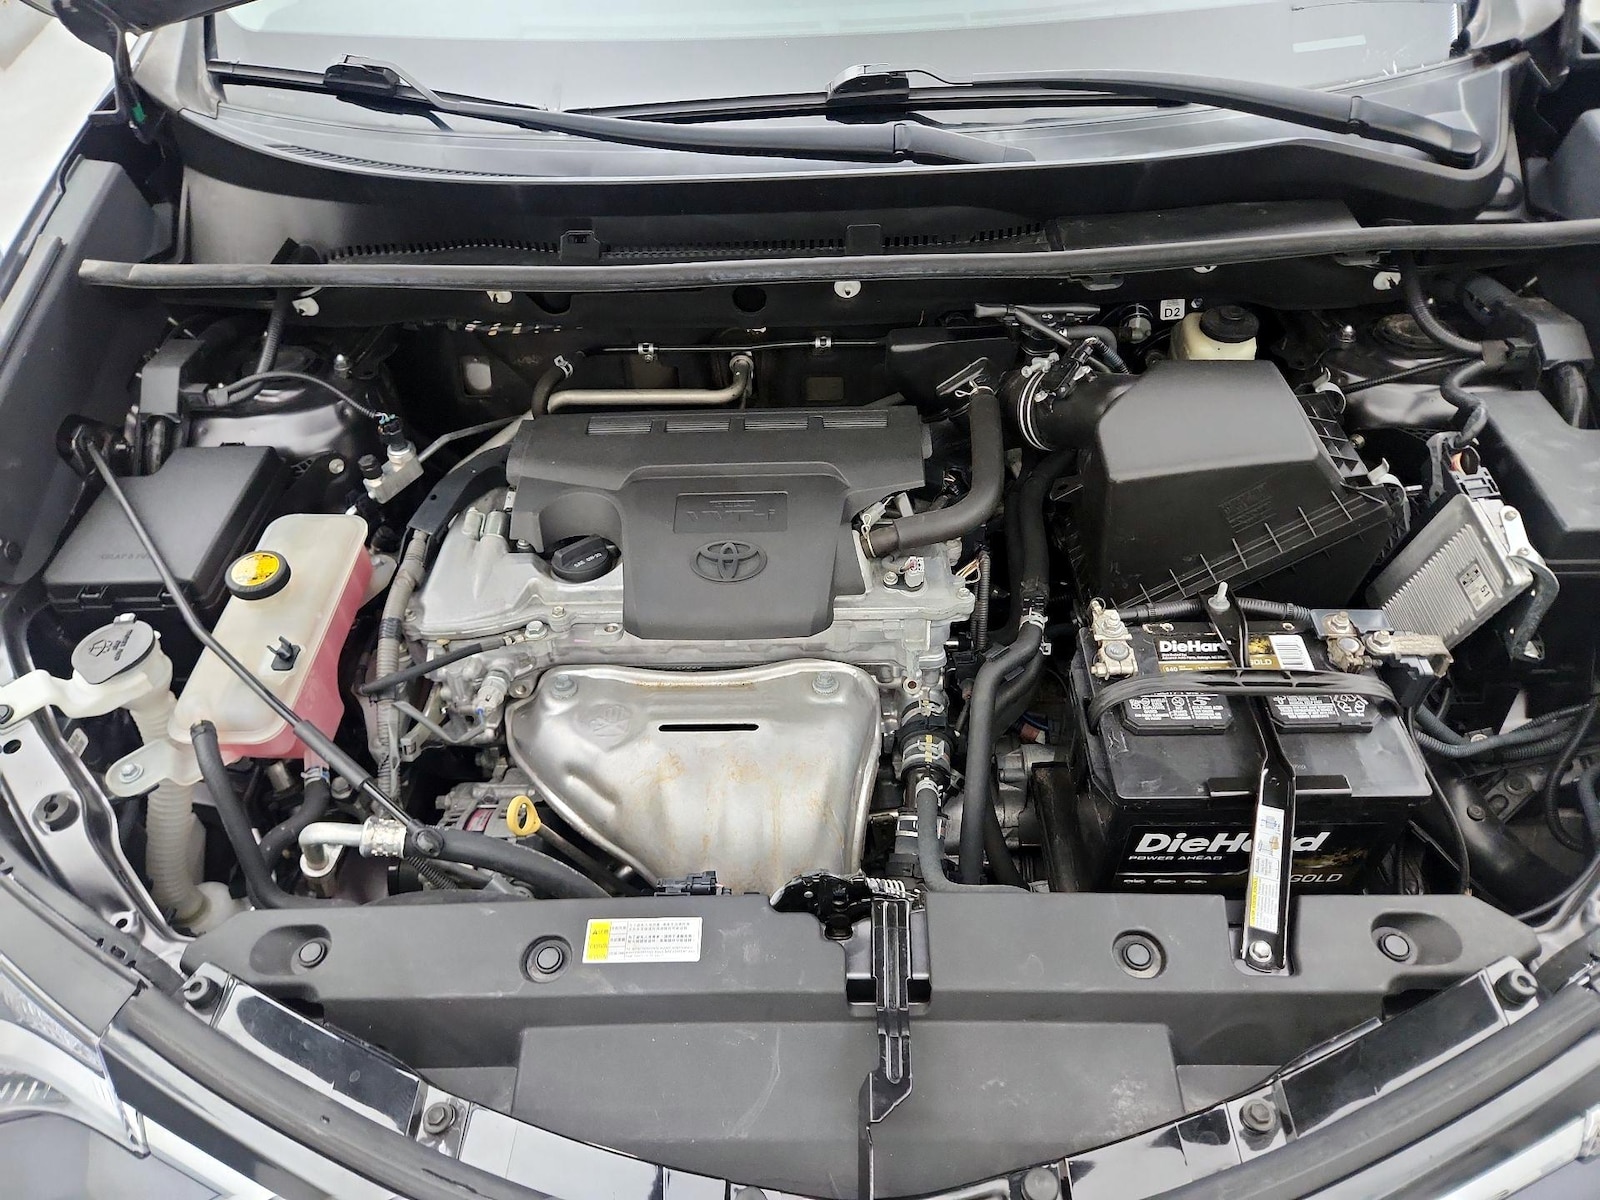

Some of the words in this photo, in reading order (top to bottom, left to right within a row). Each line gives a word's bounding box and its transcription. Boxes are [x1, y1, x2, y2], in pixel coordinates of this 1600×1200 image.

[1164, 307, 1181, 318] D2
[1135, 832, 1330, 852] DieHd
[1290, 873, 1343, 883] GOLD
